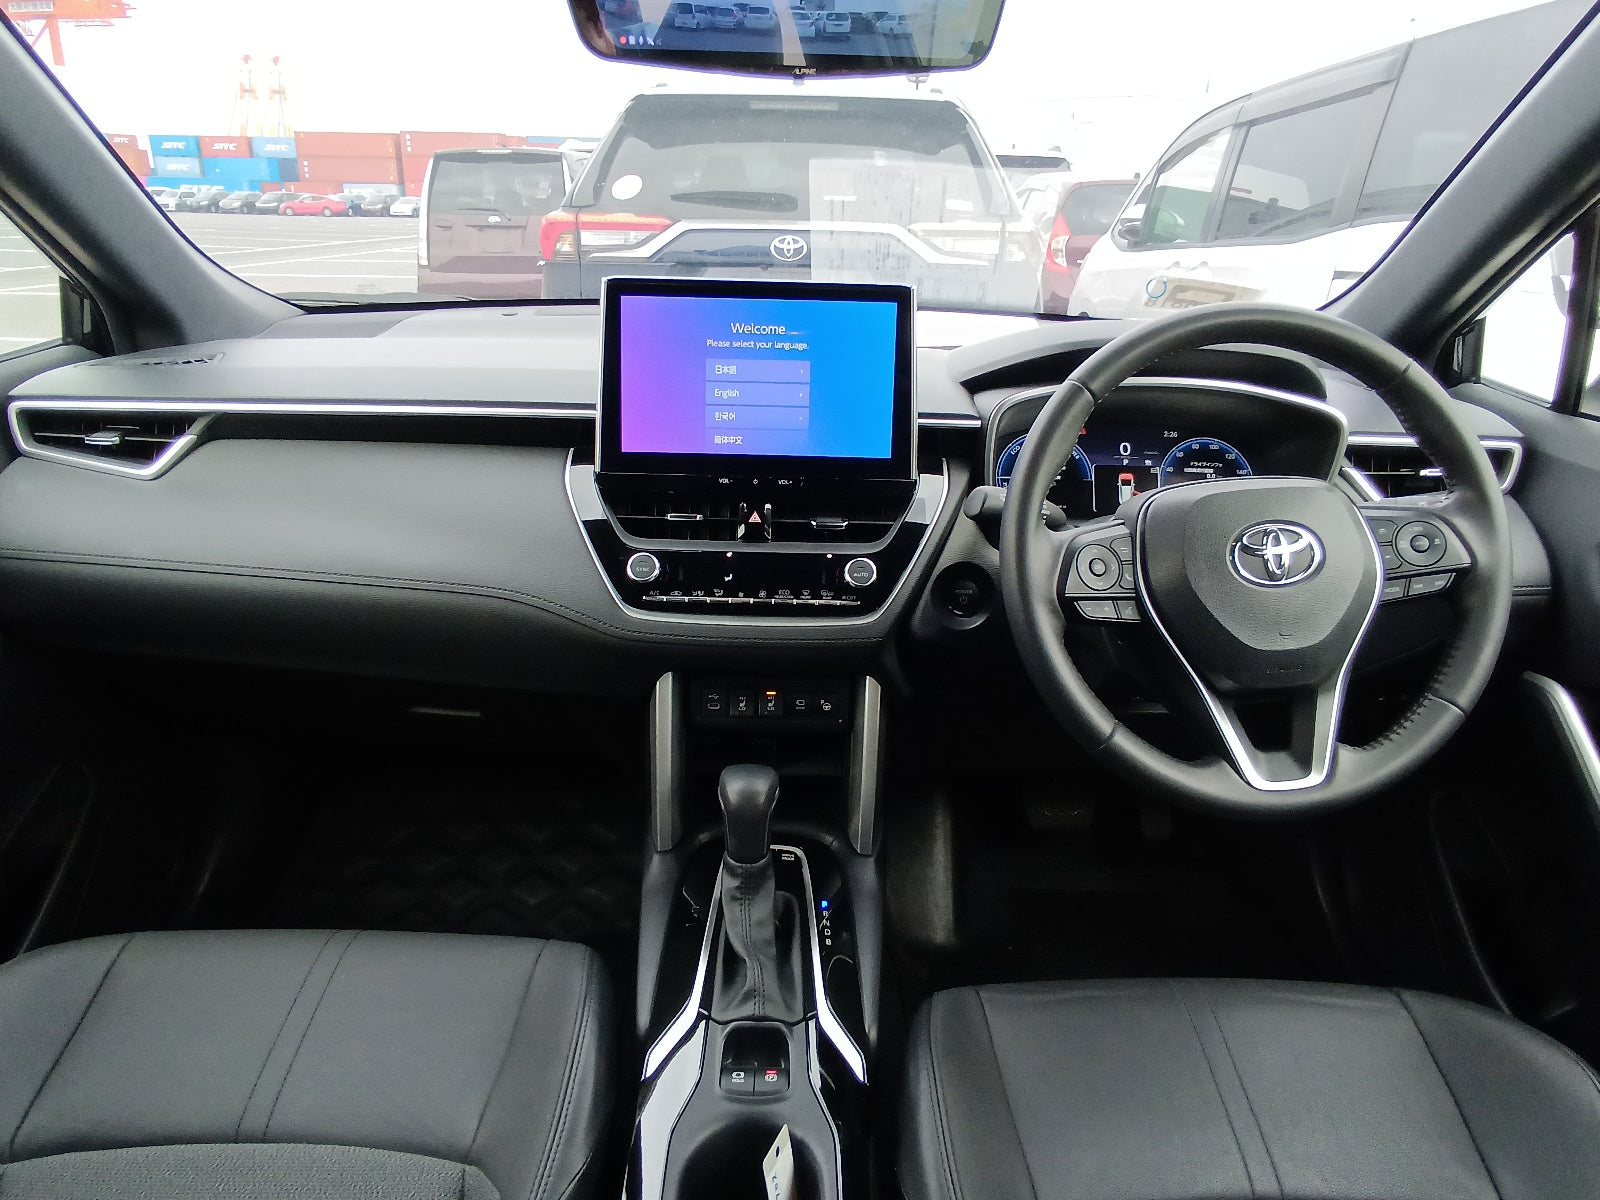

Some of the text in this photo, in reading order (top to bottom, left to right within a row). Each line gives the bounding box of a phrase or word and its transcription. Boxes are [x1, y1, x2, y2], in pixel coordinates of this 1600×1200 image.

[161, 141, 187, 149] SITC
[211, 142, 238, 151] SITC
[263, 143, 290, 152] SITC
[730, 322, 786, 335] Welcome
[706, 338, 809, 351] Please select your language.
[715, 364, 737, 375] 日本語
[714, 388, 739, 399] English
[714, 411, 736, 421] 한국어
[1119, 441, 1131, 456] 0
[1122, 458, 1129, 466] P
[821, 900, 828, 908] P
